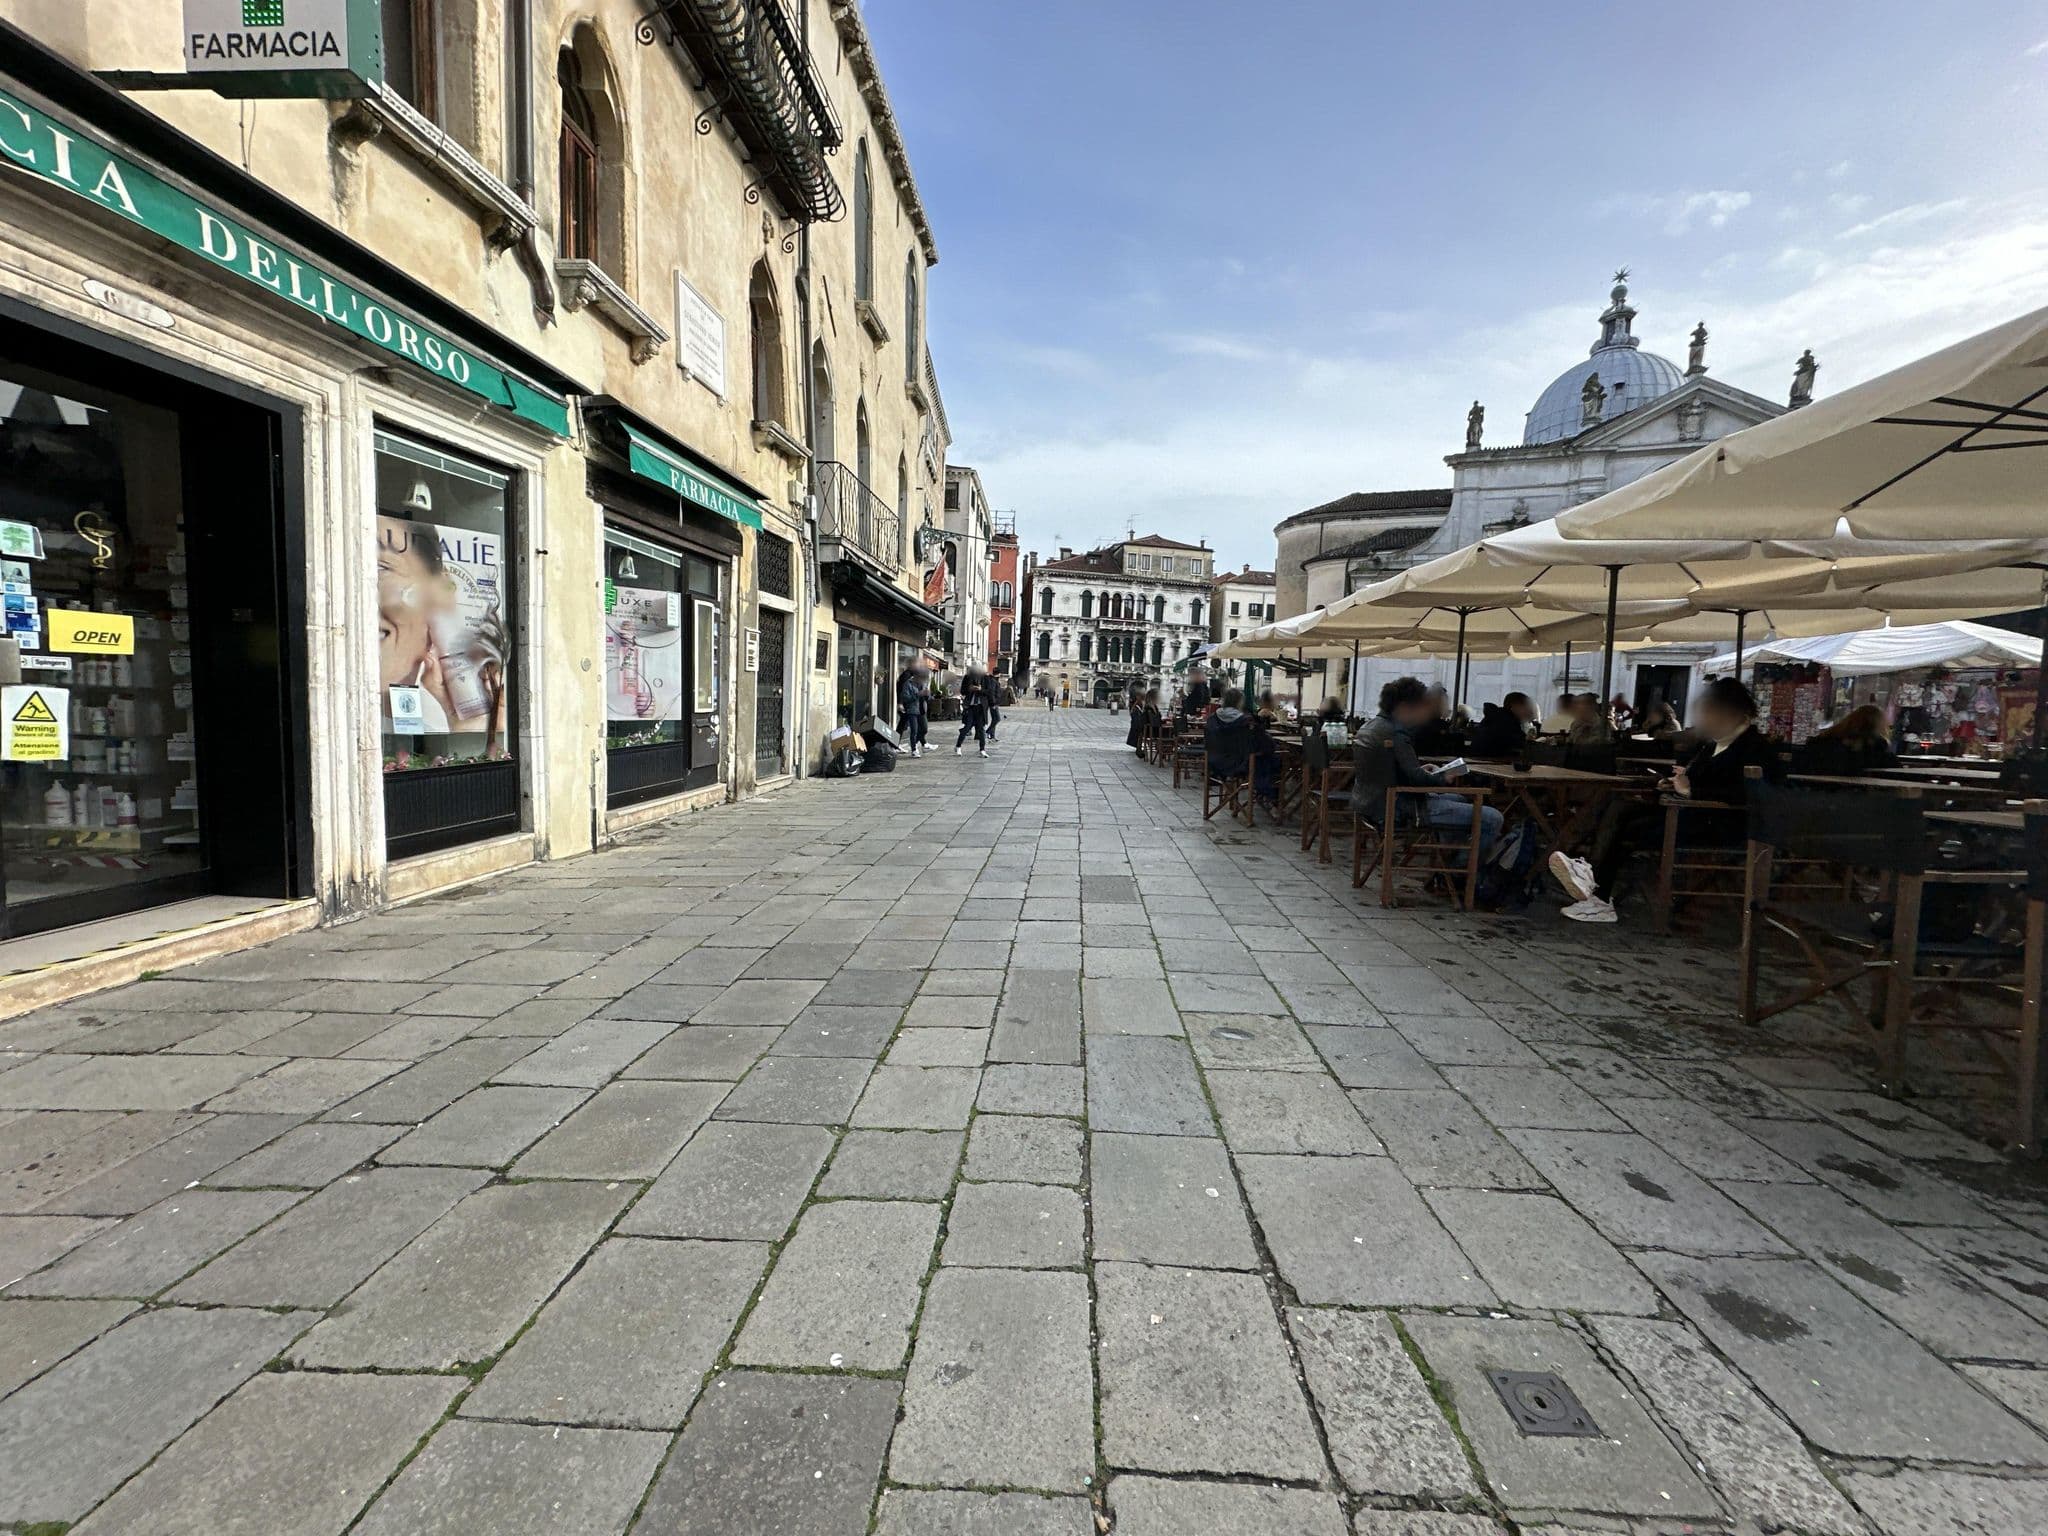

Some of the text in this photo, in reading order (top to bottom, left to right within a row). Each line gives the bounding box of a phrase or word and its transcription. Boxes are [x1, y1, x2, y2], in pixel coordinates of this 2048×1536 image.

[191, 31, 341, 59] FARMACIA
[0, 98, 470, 384] CIA DELL'ORSO
[670, 468, 740, 520] FARMACIA
[73, 630, 122, 645] OPEN
[15, 725, 55, 733] Warning
